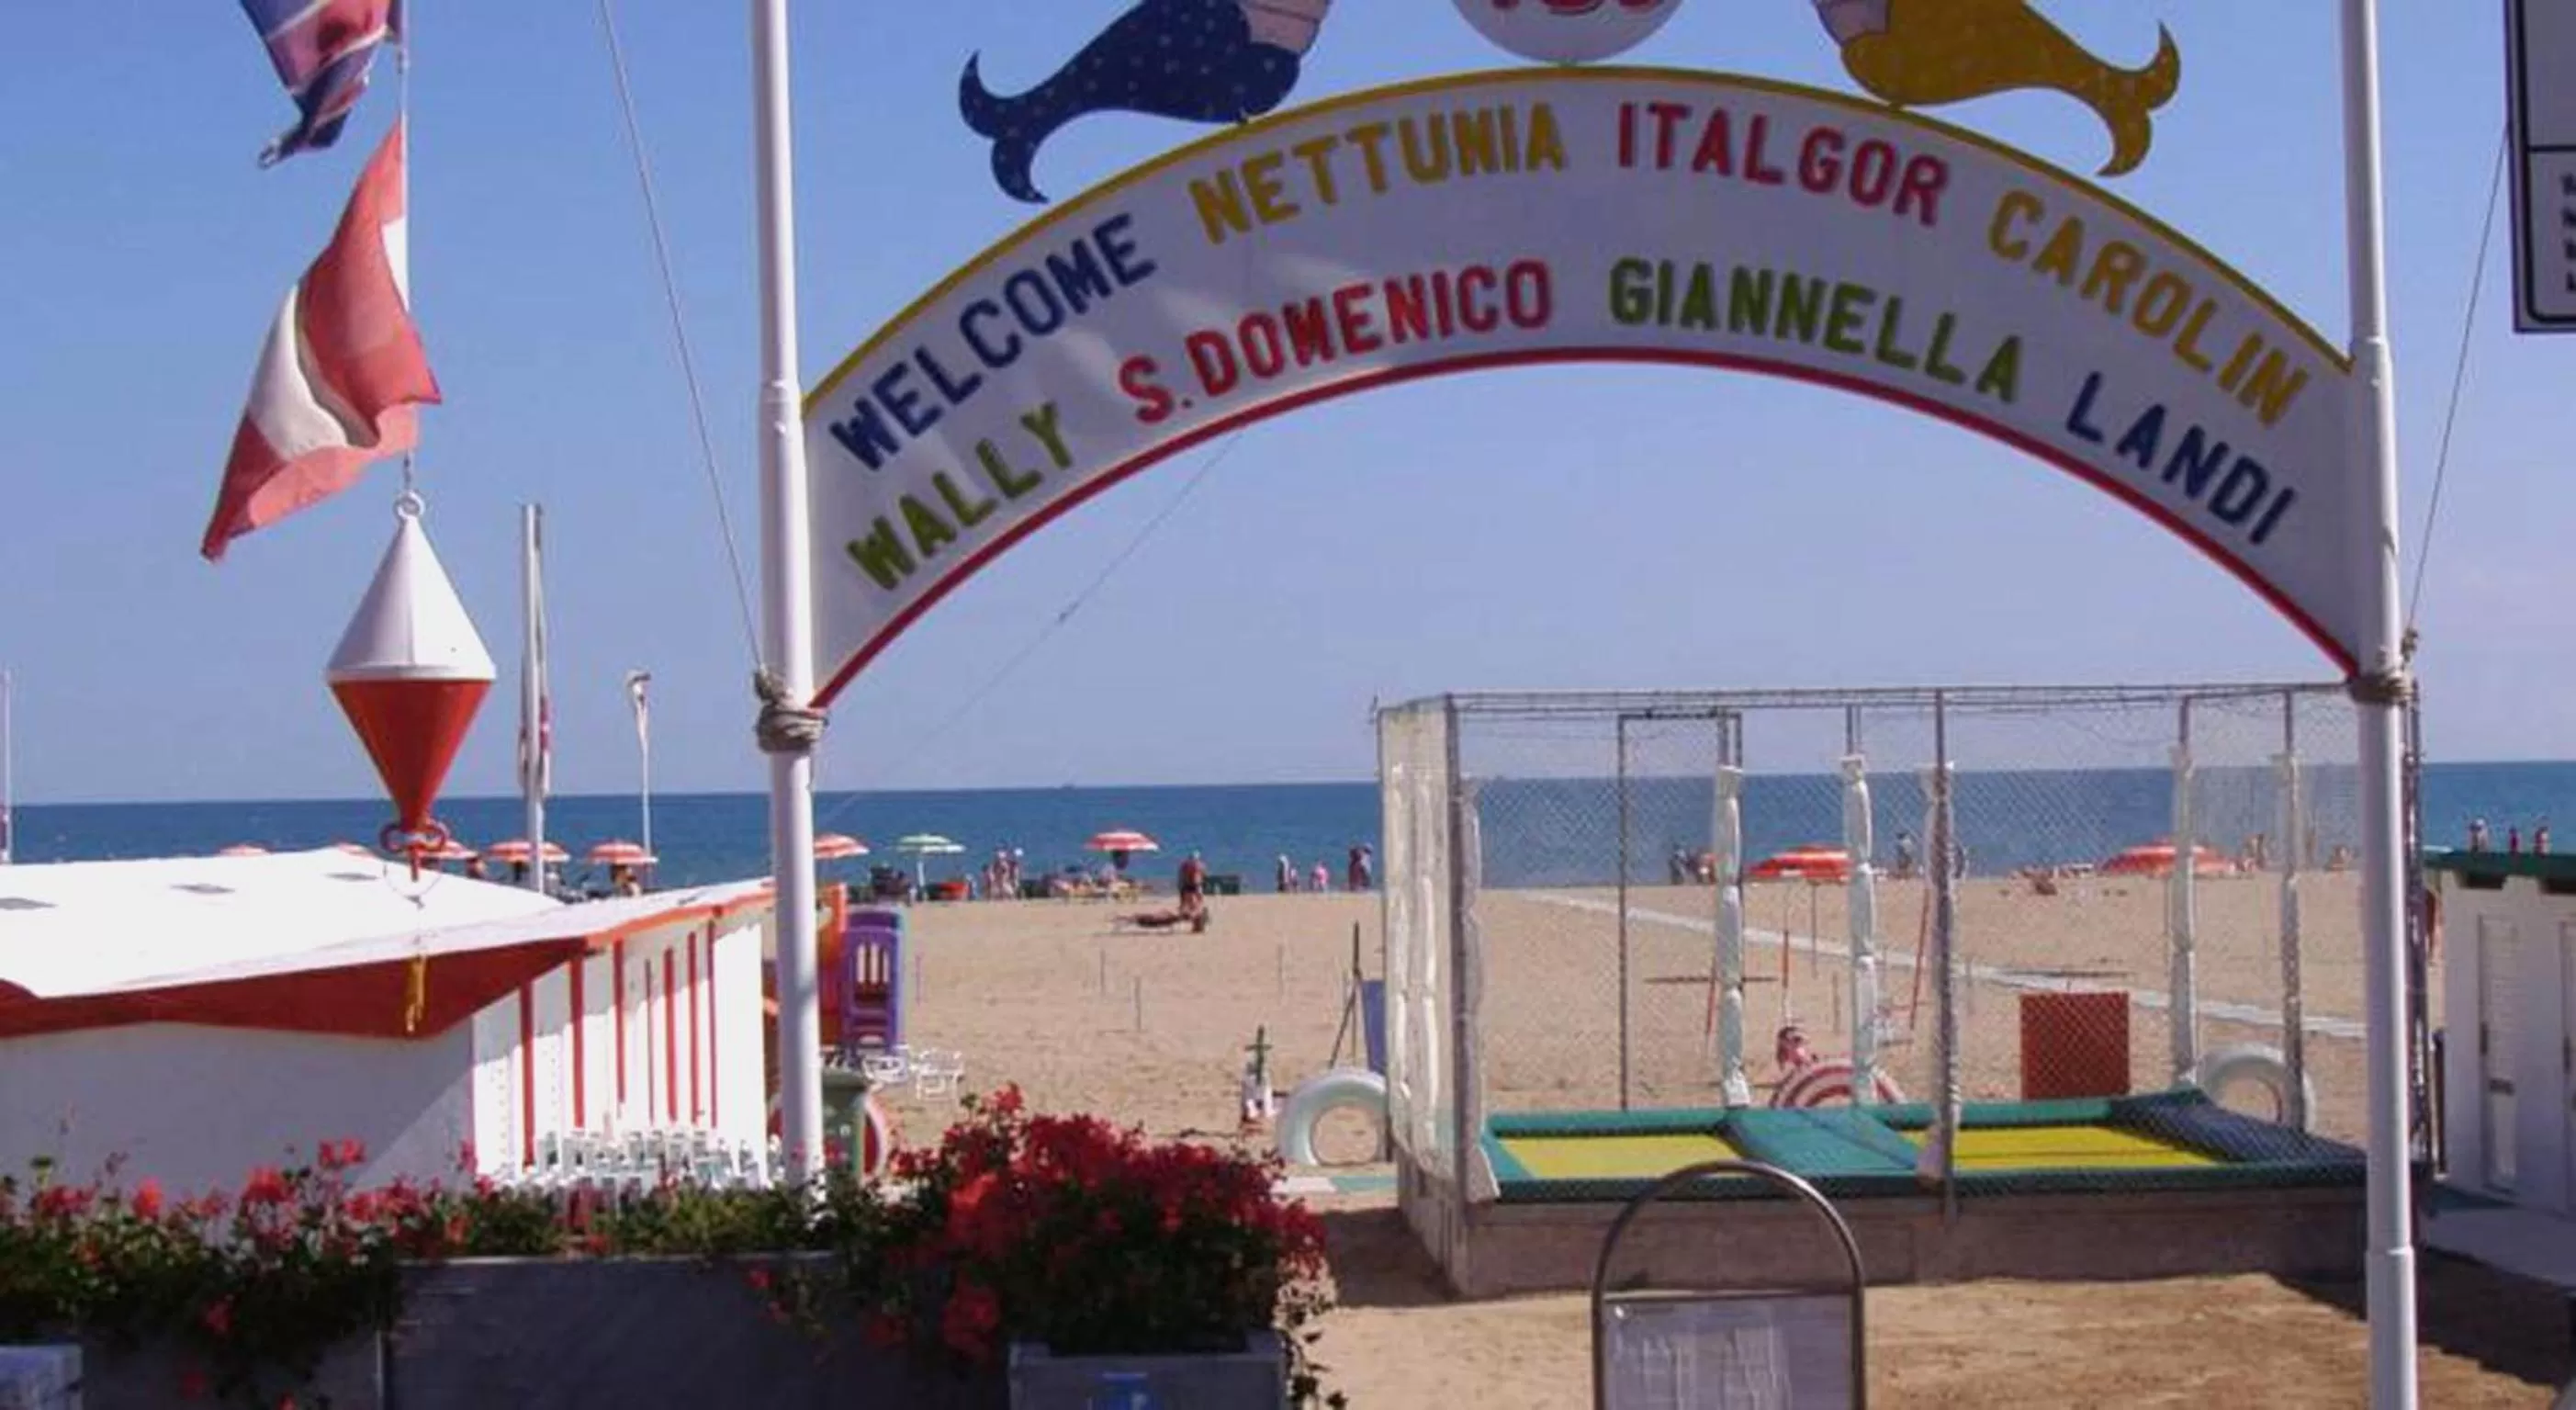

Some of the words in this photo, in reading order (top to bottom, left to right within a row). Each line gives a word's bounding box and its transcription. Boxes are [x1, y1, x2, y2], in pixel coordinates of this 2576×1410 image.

[830, 213, 1156, 470] WELCOME
[1188, 103, 1567, 244] NETTUNIA
[1618, 102, 1948, 226] ITALGOR
[1989, 190, 2308, 427] CAROLIN
[847, 402, 1073, 592] WALLY
[1610, 257, 2021, 402] GIANNELLA
[2064, 371, 2298, 545] LANDI
